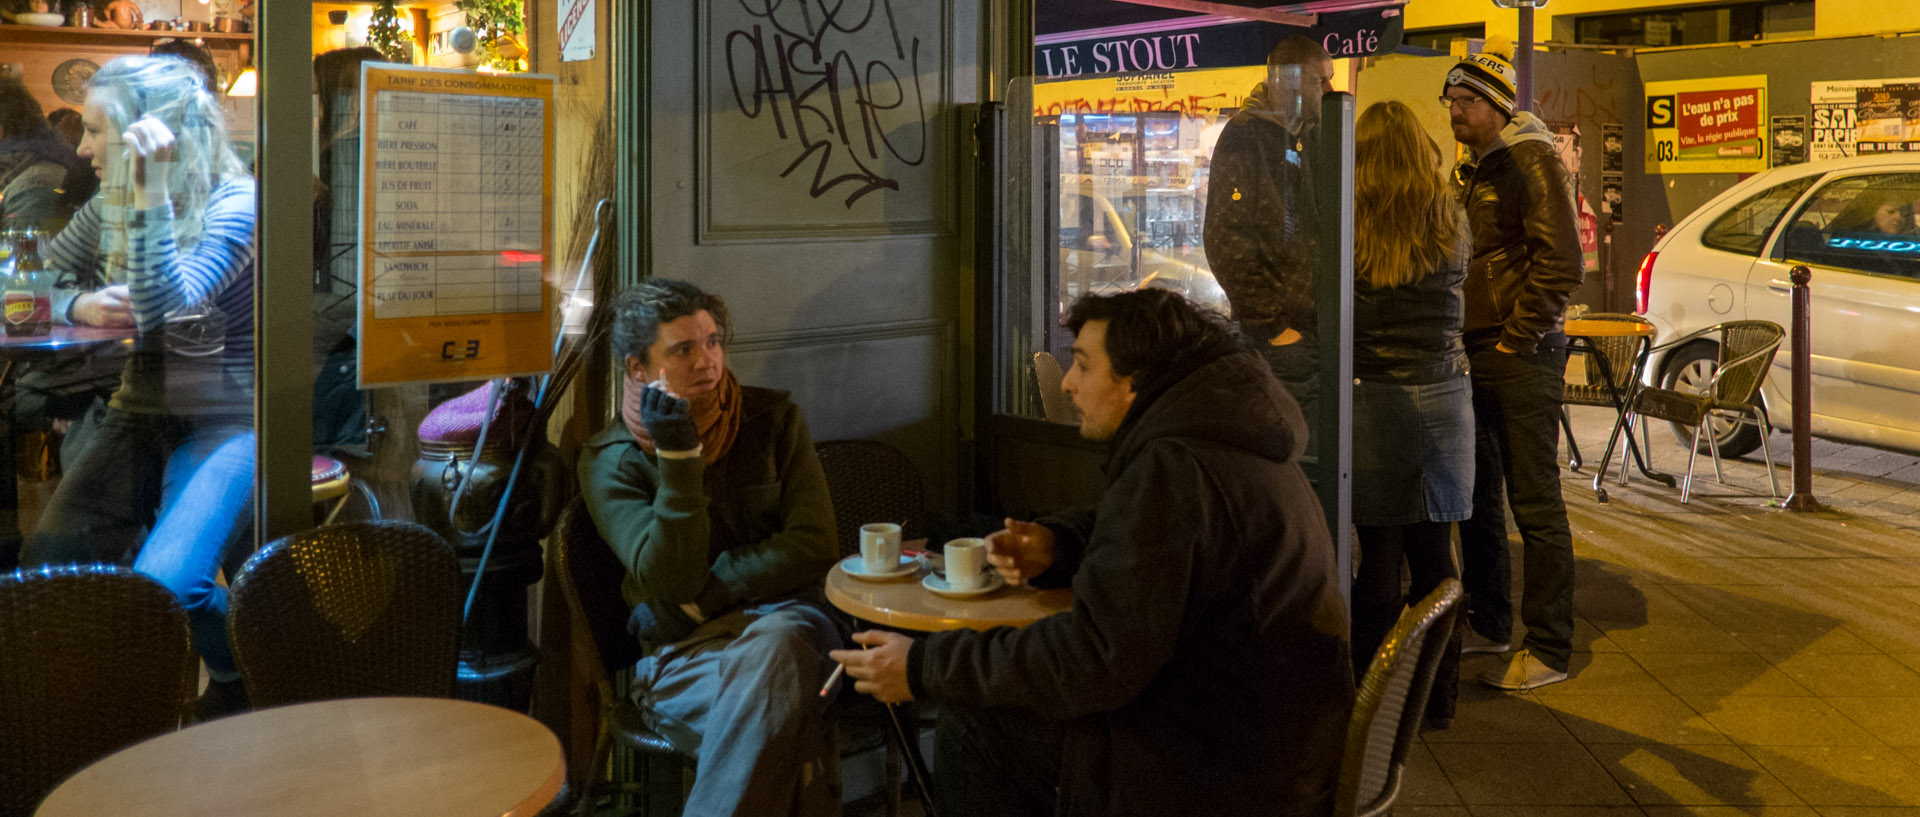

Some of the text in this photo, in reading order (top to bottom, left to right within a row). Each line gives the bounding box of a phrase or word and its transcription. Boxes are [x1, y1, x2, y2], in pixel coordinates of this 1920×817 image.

[1323, 29, 1378, 57] Café
[1042, 33, 1200, 78] LE STOUT
[387, 75, 537, 93] TARIF DES CONSOMMATIONS
[1826, 85, 1860, 93] Menuis
[1652, 98, 1671, 125] S
[1682, 94, 1754, 116] L'eau n'a pas
[398, 119, 418, 130] CAFÉ
[1700, 110, 1738, 127] de prix
[1697, 133, 1704, 141] la
[1706, 131, 1723, 143] régie
[1724, 128, 1755, 141] publique
[400, 141, 438, 151] PRESSION
[1657, 140, 1678, 161] 03.
[395, 201, 418, 210] SODA
[396, 220, 434, 230] MINÉRALE
[383, 262, 428, 272] SANDWICH
[413, 289, 434, 301] JOUR
